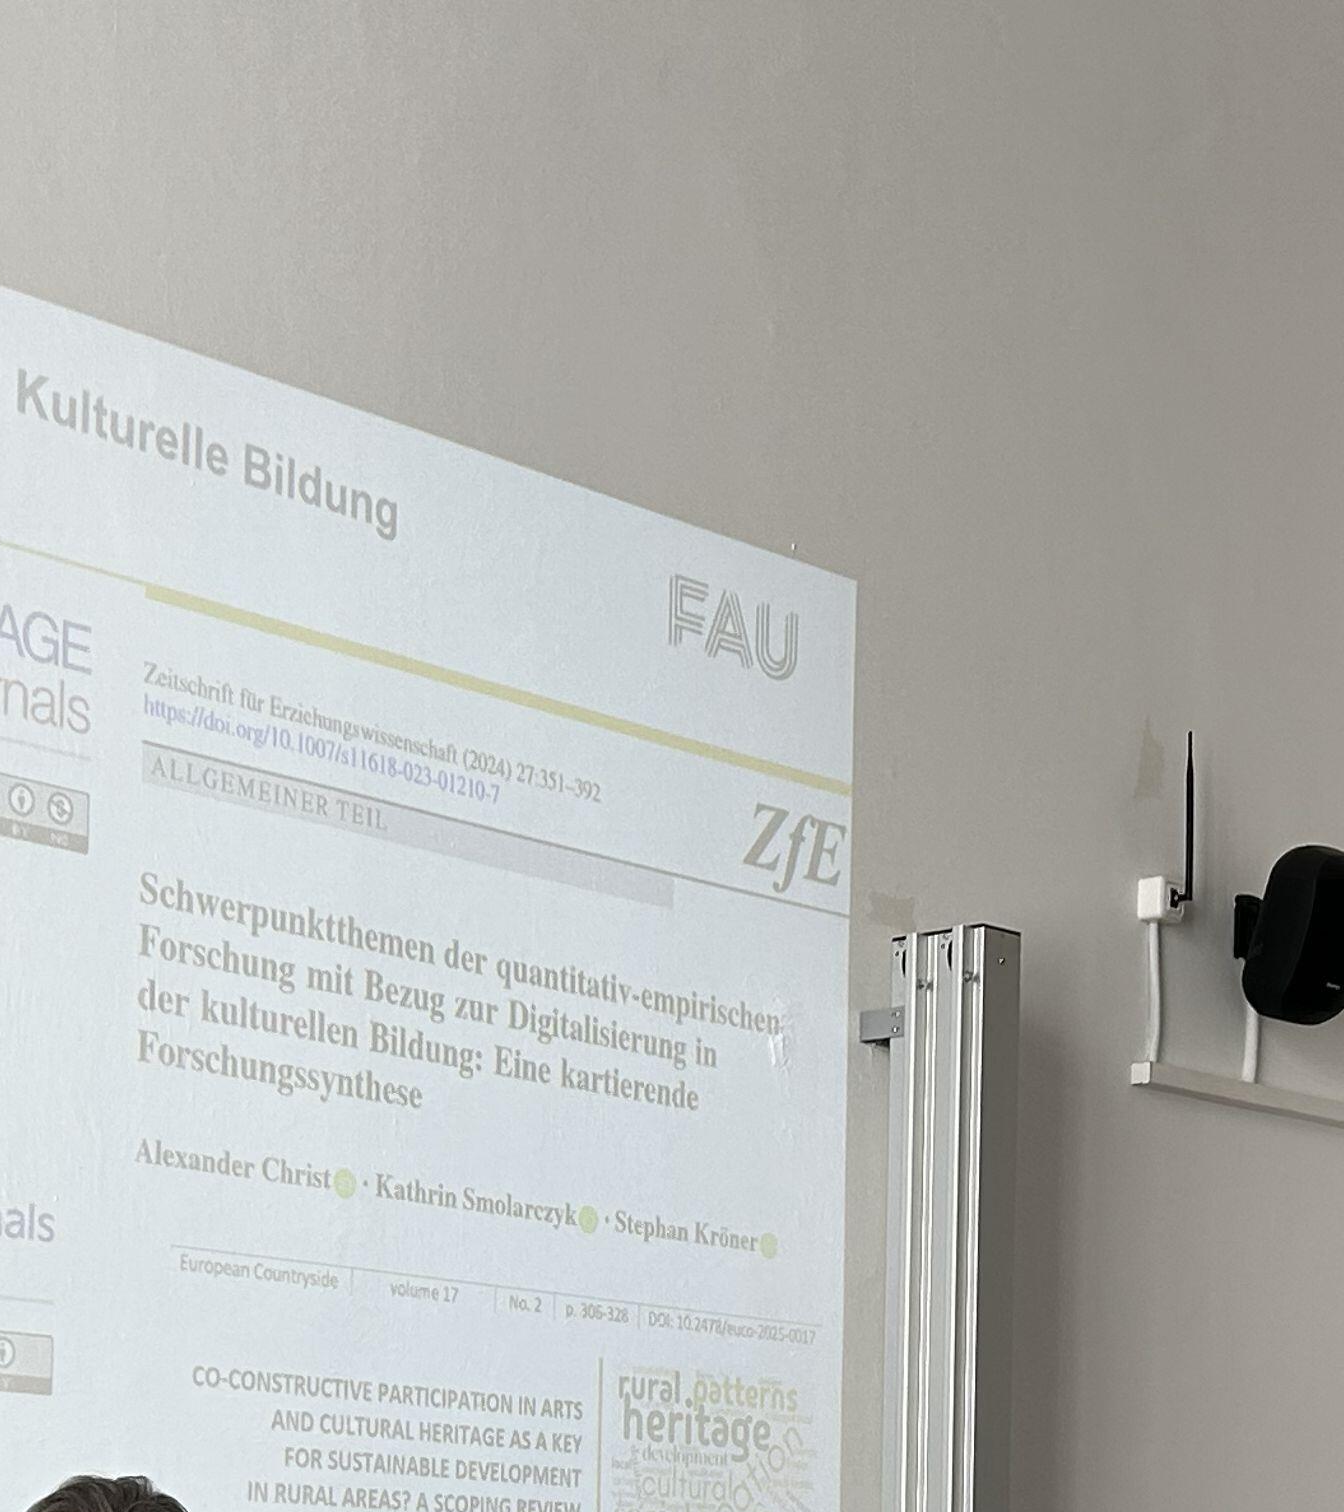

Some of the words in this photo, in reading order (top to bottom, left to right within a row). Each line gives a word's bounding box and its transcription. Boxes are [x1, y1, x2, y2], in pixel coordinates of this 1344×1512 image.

[17, 368, 228, 477] Kulturelle
[244, 443, 397, 542] Bildung
[668, 573, 800, 682] FAU
[144, 661, 235, 705] Zeitschrift
[270, 695, 459, 767] Erziehungswissenschaft
[462, 746, 513, 783] (2024)
[151, 755, 329, 817] ALLGEMEINER
[336, 798, 388, 832] TEIL
[743, 802, 847, 893] ZfE
[139, 870, 435, 968] Schwerpunktthemen
[444, 938, 487, 976] der
[497, 957, 782, 1037] quantitativ-empirischen
[139, 921, 296, 994] Forschung
[307, 963, 354, 998] mit
[365, 968, 445, 1025] Bezug
[508, 998, 687, 1068] Digitalisierung
[137, 1028, 423, 1111] Forschungssynthese
[138, 978, 190, 1018] der
[201, 985, 358, 1050] kulturellen
[370, 1020, 483, 1077] Bildung:
[494, 1045, 551, 1087] Eine
[561, 1058, 700, 1113] kartierende
[135, 1138, 255, 1182] Alexander
[262, 1156, 331, 1193] Christ
[375, 1173, 457, 1210] Kathrin
[462, 1186, 577, 1231] Smolarczyk
[614, 1208, 688, 1247] Stephan
[694, 1221, 759, 1254] Kröner
[179, 1254, 251, 1282] European
[254, 1262, 339, 1291] Countryside
[192, 1365, 373, 1402] CO-CONSTRUCTIVE
[378, 1381, 515, 1416] PARTICIPATION
[541, 1396, 584, 1421] ARTS
[617, 1370, 680, 1404] rural
[693, 1376, 799, 1412] patterns
[623, 1393, 771, 1463] heritage
[271, 1409, 316, 1433] AND
[320, 1412, 414, 1441] CULTURAL
[418, 1419, 507, 1447] HERITAGE
[552, 1429, 583, 1454] KEY
[285, 1446, 324, 1470] FOR
[327, 1450, 451, 1480] SUSTAINABLE
[455, 1458, 583, 1489] DEVELOPMENT
[641, 1445, 729, 1468] development
[274, 1482, 338, 1509] RURAL
[342, 1485, 413, 1512] AREAS?
[640, 1467, 733, 1502] cultural
